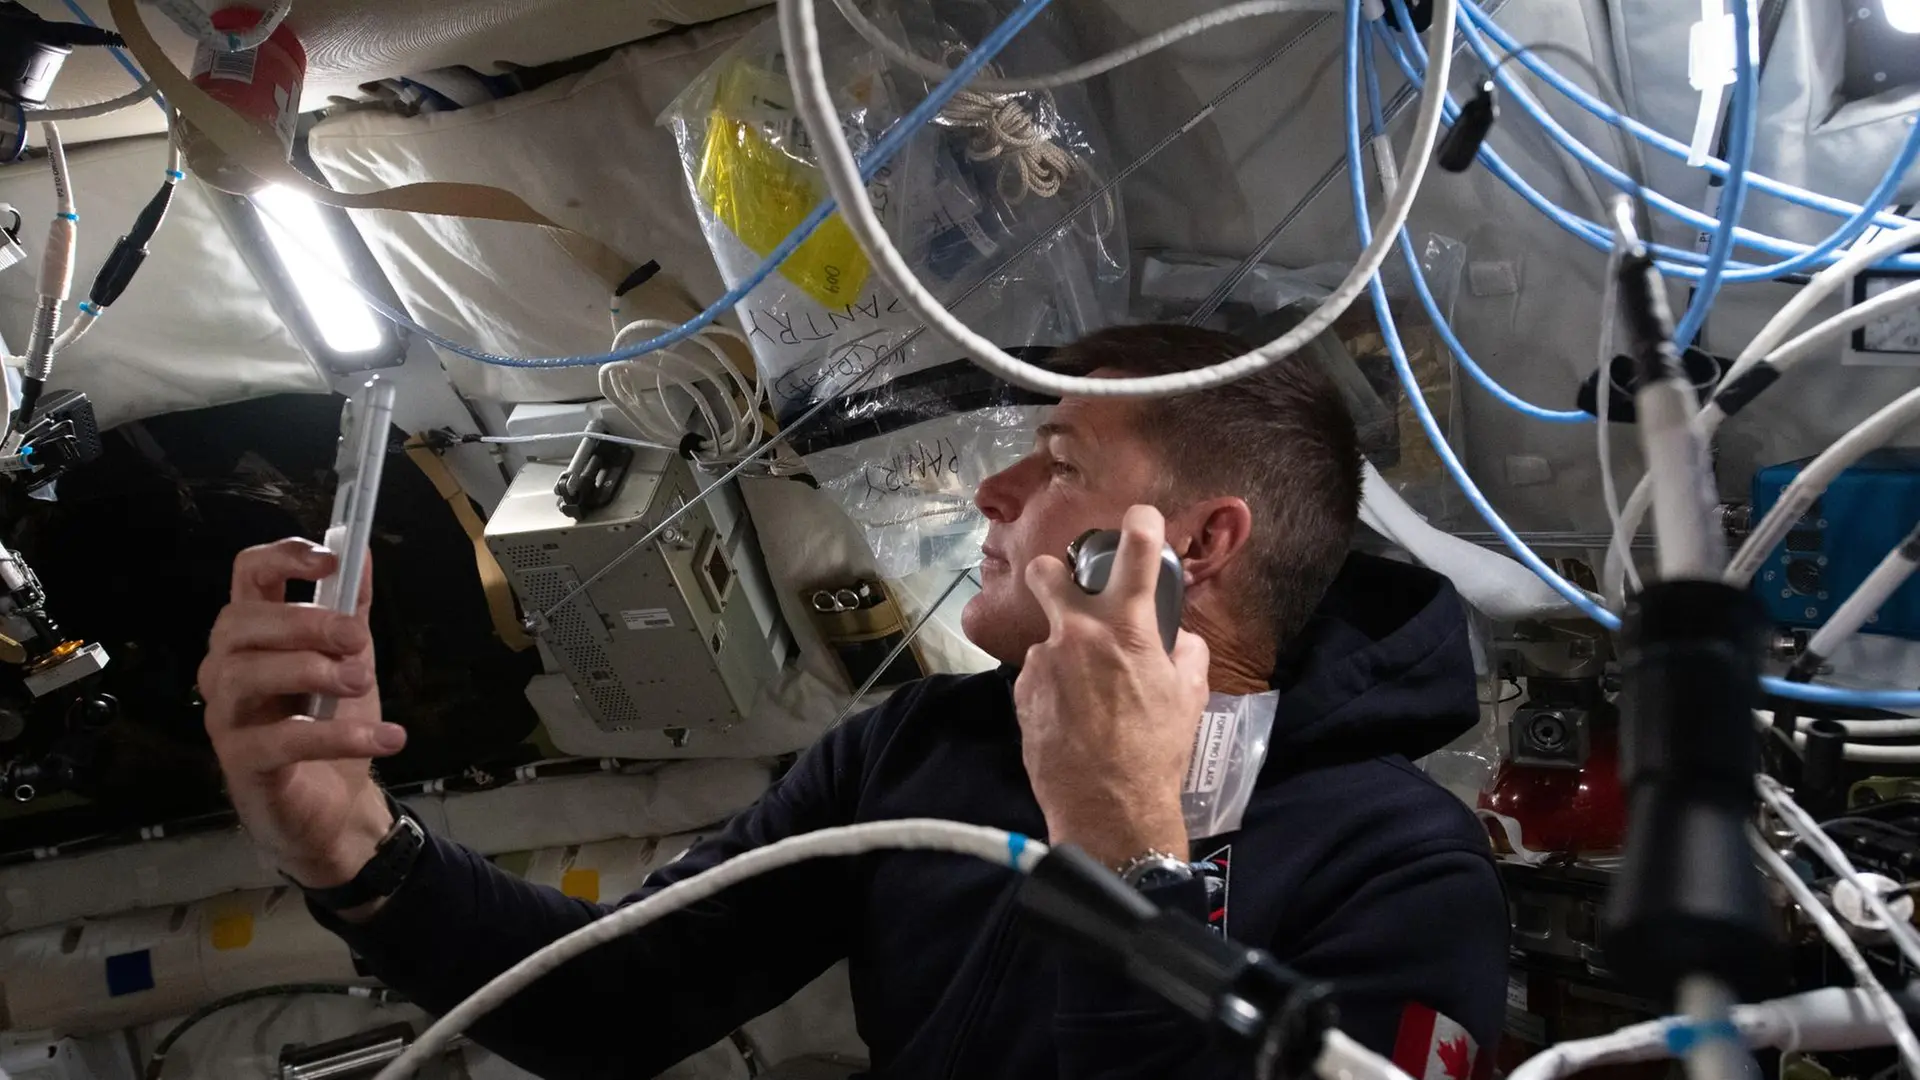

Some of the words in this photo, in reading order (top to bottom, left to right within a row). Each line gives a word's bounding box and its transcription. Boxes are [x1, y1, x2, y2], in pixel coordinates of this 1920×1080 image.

[864, 436, 961, 501] PANTRY
[1212, 714, 1227, 740] FORTE
[1209, 741, 1221, 758] PRO
